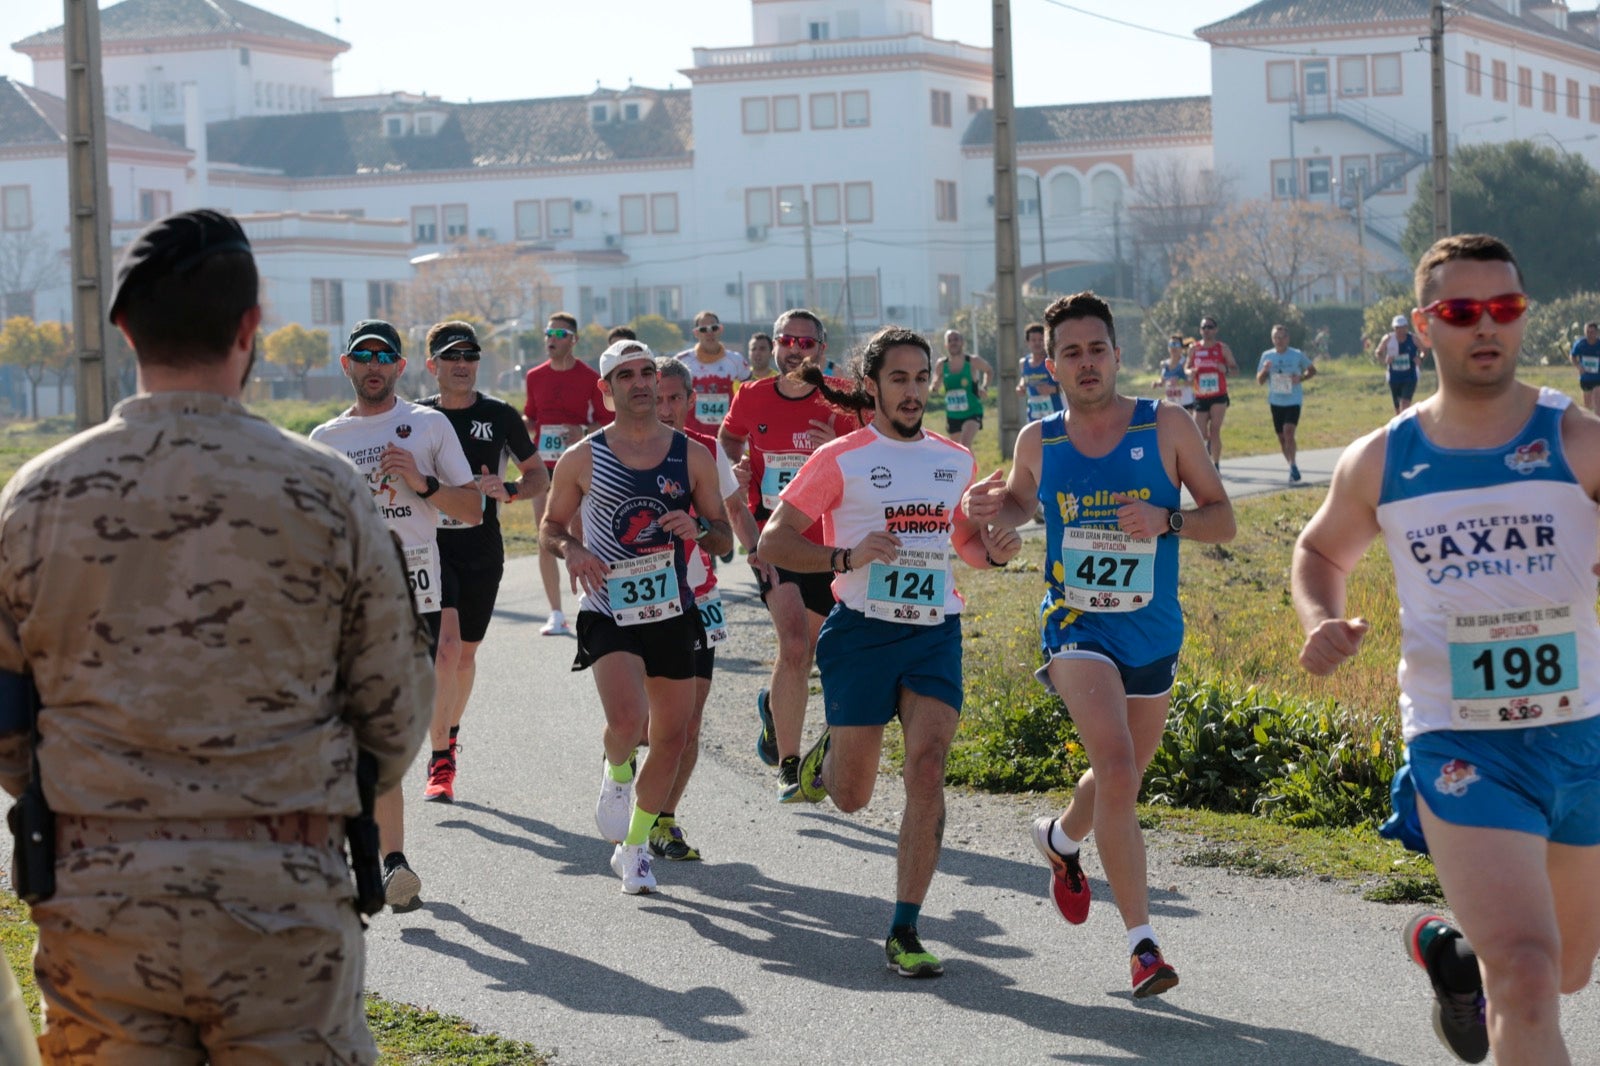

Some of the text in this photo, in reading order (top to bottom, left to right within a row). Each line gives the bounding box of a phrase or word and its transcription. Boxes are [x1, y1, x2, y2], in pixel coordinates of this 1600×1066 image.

[702, 403, 724, 414] 944
[545, 436, 567, 449] 89
[778, 472, 797, 491] 5
[380, 505, 412, 519] inas
[885, 501, 945, 519] BABOLÉ
[1082, 508, 1118, 518] deport
[1406, 514, 1554, 540] CLUB ATLETISMO
[1086, 532, 1100, 541] GRAN
[1102, 534, 1123, 543] PREMIO
[1410, 526, 1556, 564] CAXAR
[1077, 556, 1139, 587] 427
[1527, 553, 1557, 574] FIT
[621, 573, 667, 604] 337
[885, 570, 935, 601] 124
[1473, 643, 1562, 691] 198
